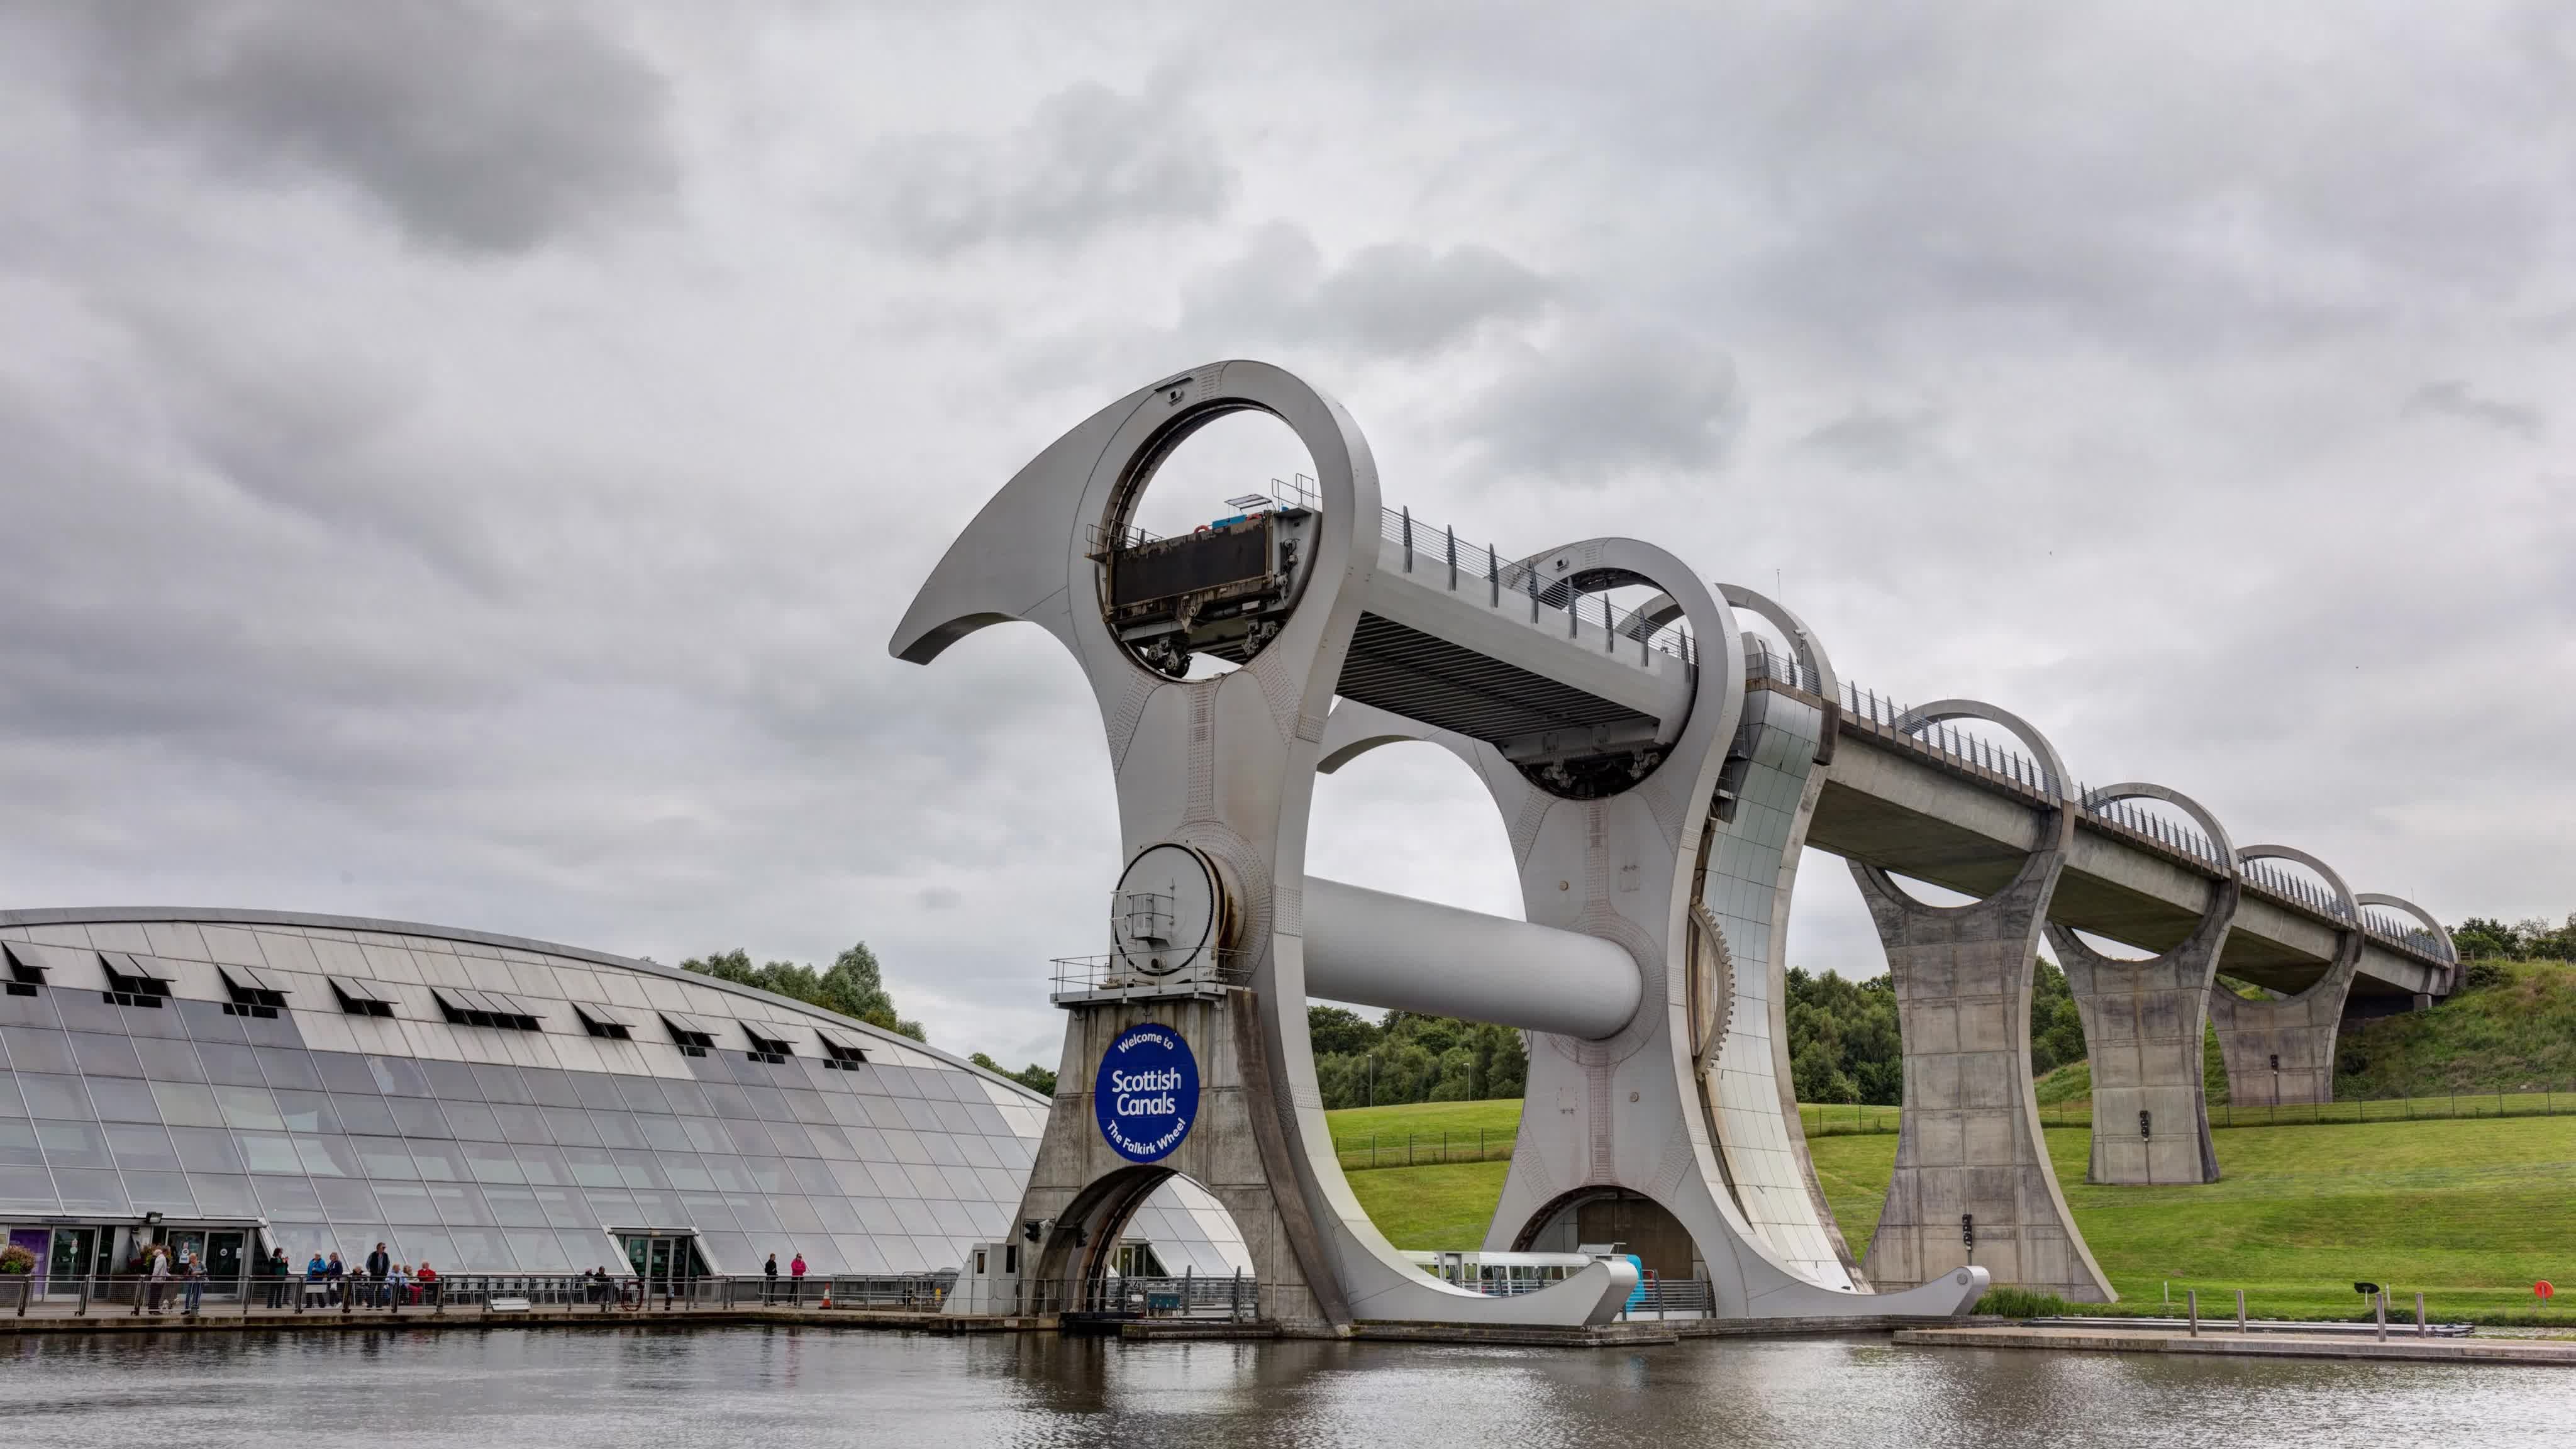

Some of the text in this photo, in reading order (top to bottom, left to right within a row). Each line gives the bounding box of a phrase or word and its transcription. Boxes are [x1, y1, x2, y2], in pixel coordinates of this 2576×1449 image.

[1118, 1033, 1174, 1053] Welcome to
[1112, 1067, 1182, 1092] Scottish
[1117, 1092, 1175, 1116] Canals
[1108, 1117, 1186, 1155] The Falkirk Wheel
